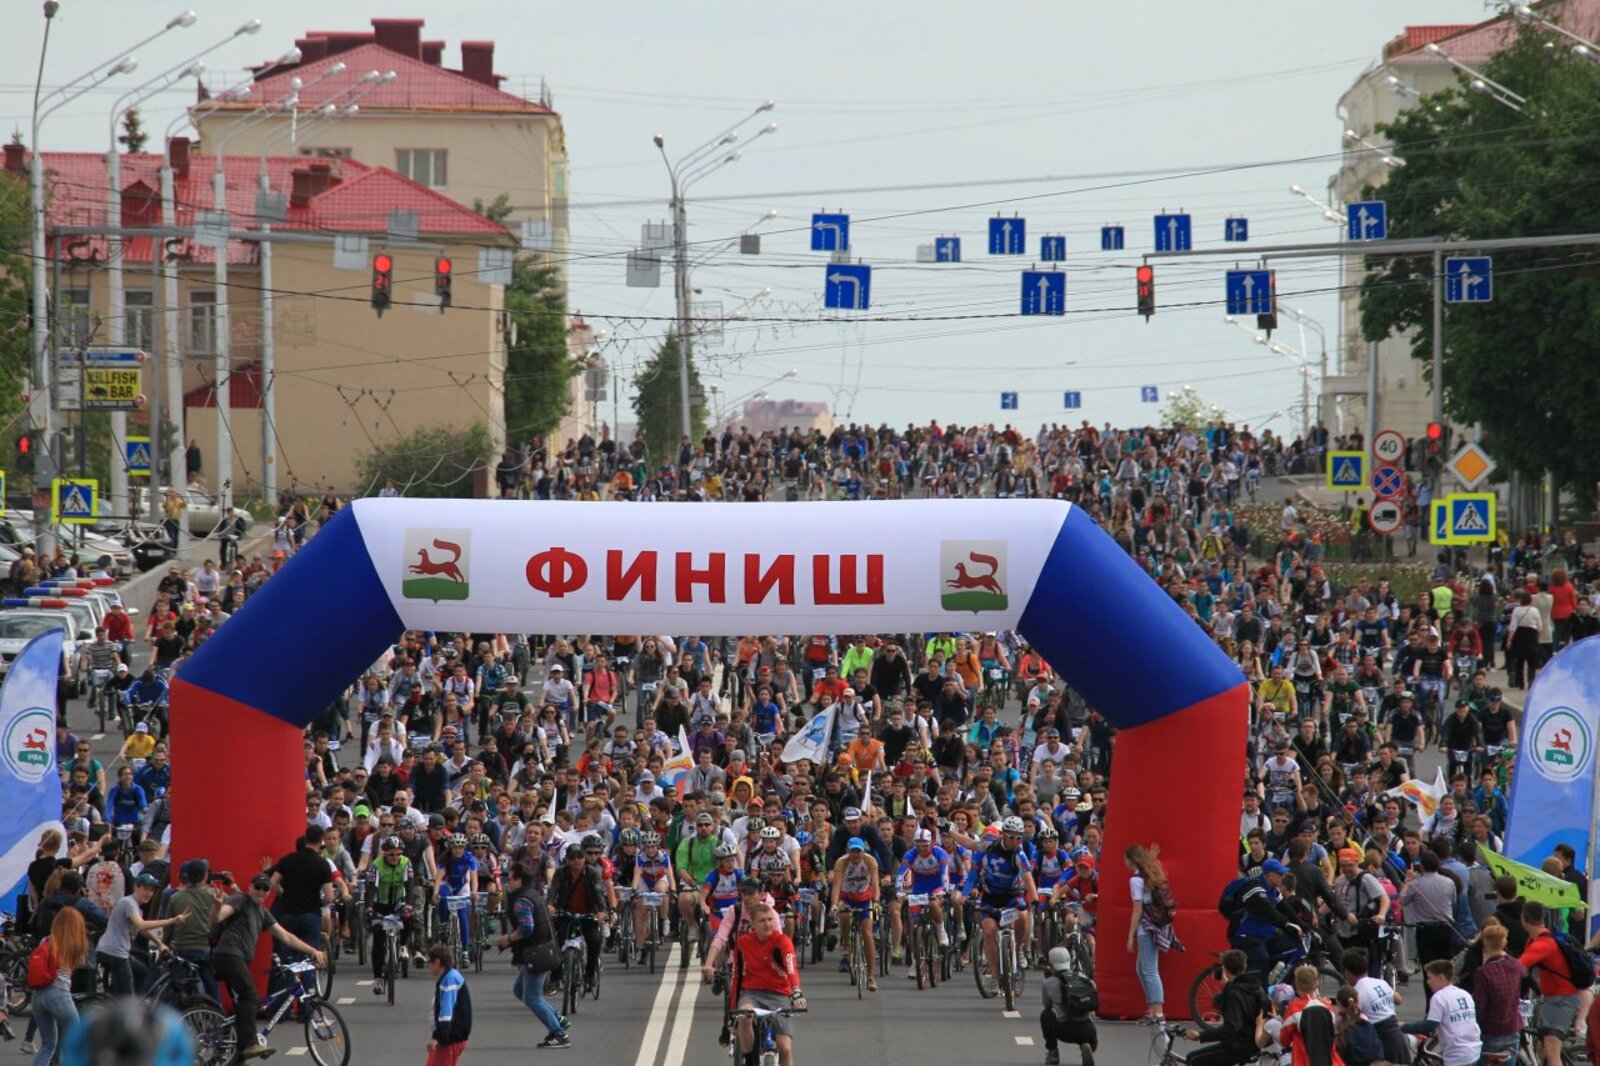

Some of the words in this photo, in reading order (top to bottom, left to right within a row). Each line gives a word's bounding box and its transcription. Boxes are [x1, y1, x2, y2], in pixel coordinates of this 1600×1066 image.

[88, 371, 137, 384] KILLFISH
[110, 386, 134, 398] BAR
[1379, 439, 1398, 453] 40
[526, 547, 884, 605] ФИНИШ
